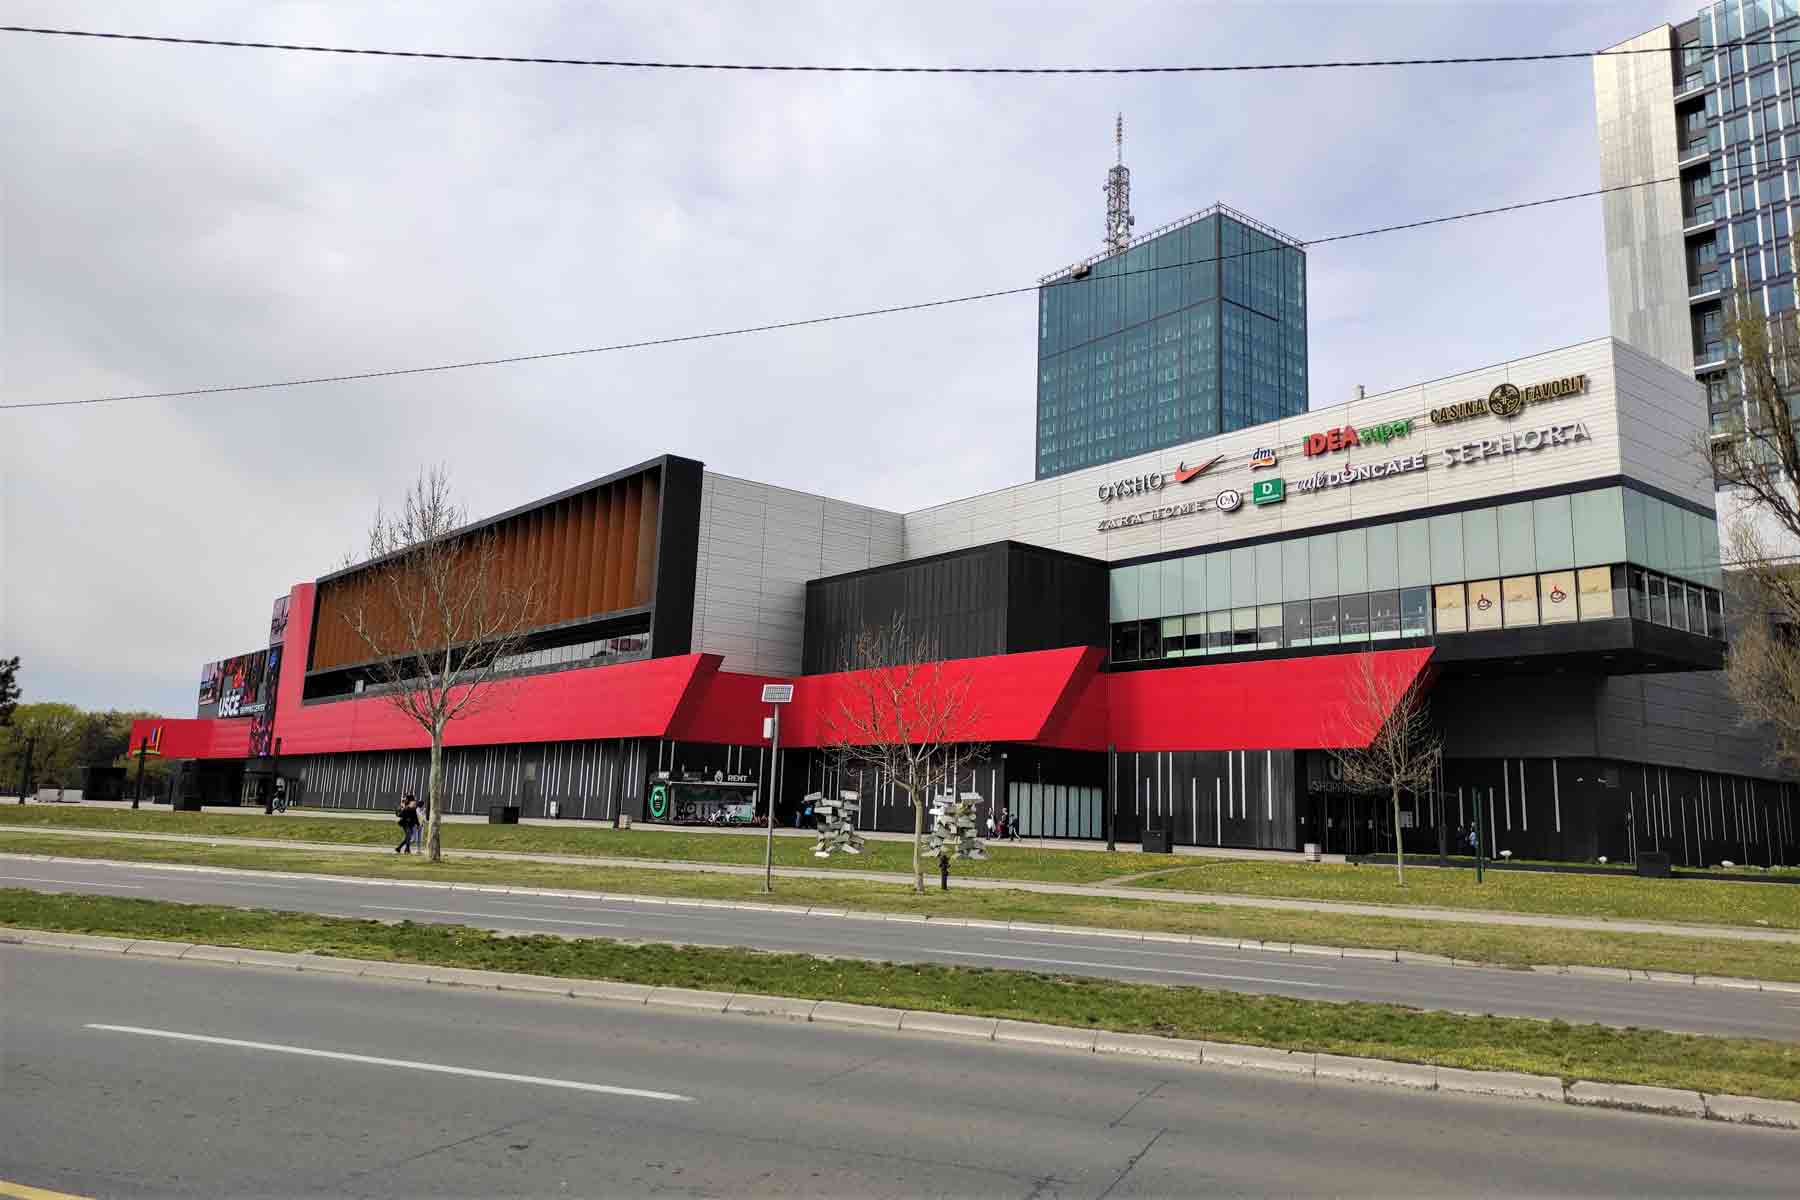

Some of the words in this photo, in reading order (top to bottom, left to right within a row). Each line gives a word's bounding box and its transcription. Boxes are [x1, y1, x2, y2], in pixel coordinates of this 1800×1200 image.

[1525, 374, 1585, 401] FAVORIT
[1359, 419, 1413, 445] super
[1442, 423, 1592, 466] SEPHORA
[1252, 447, 1271, 460] dm
[1328, 449, 1426, 484] DONCAFÉ
[1097, 472, 1164, 501] OYSHO
[1096, 512, 1144, 531] ZARA
[1151, 502, 1204, 521] HOME
[727, 774, 748, 782] RENT
